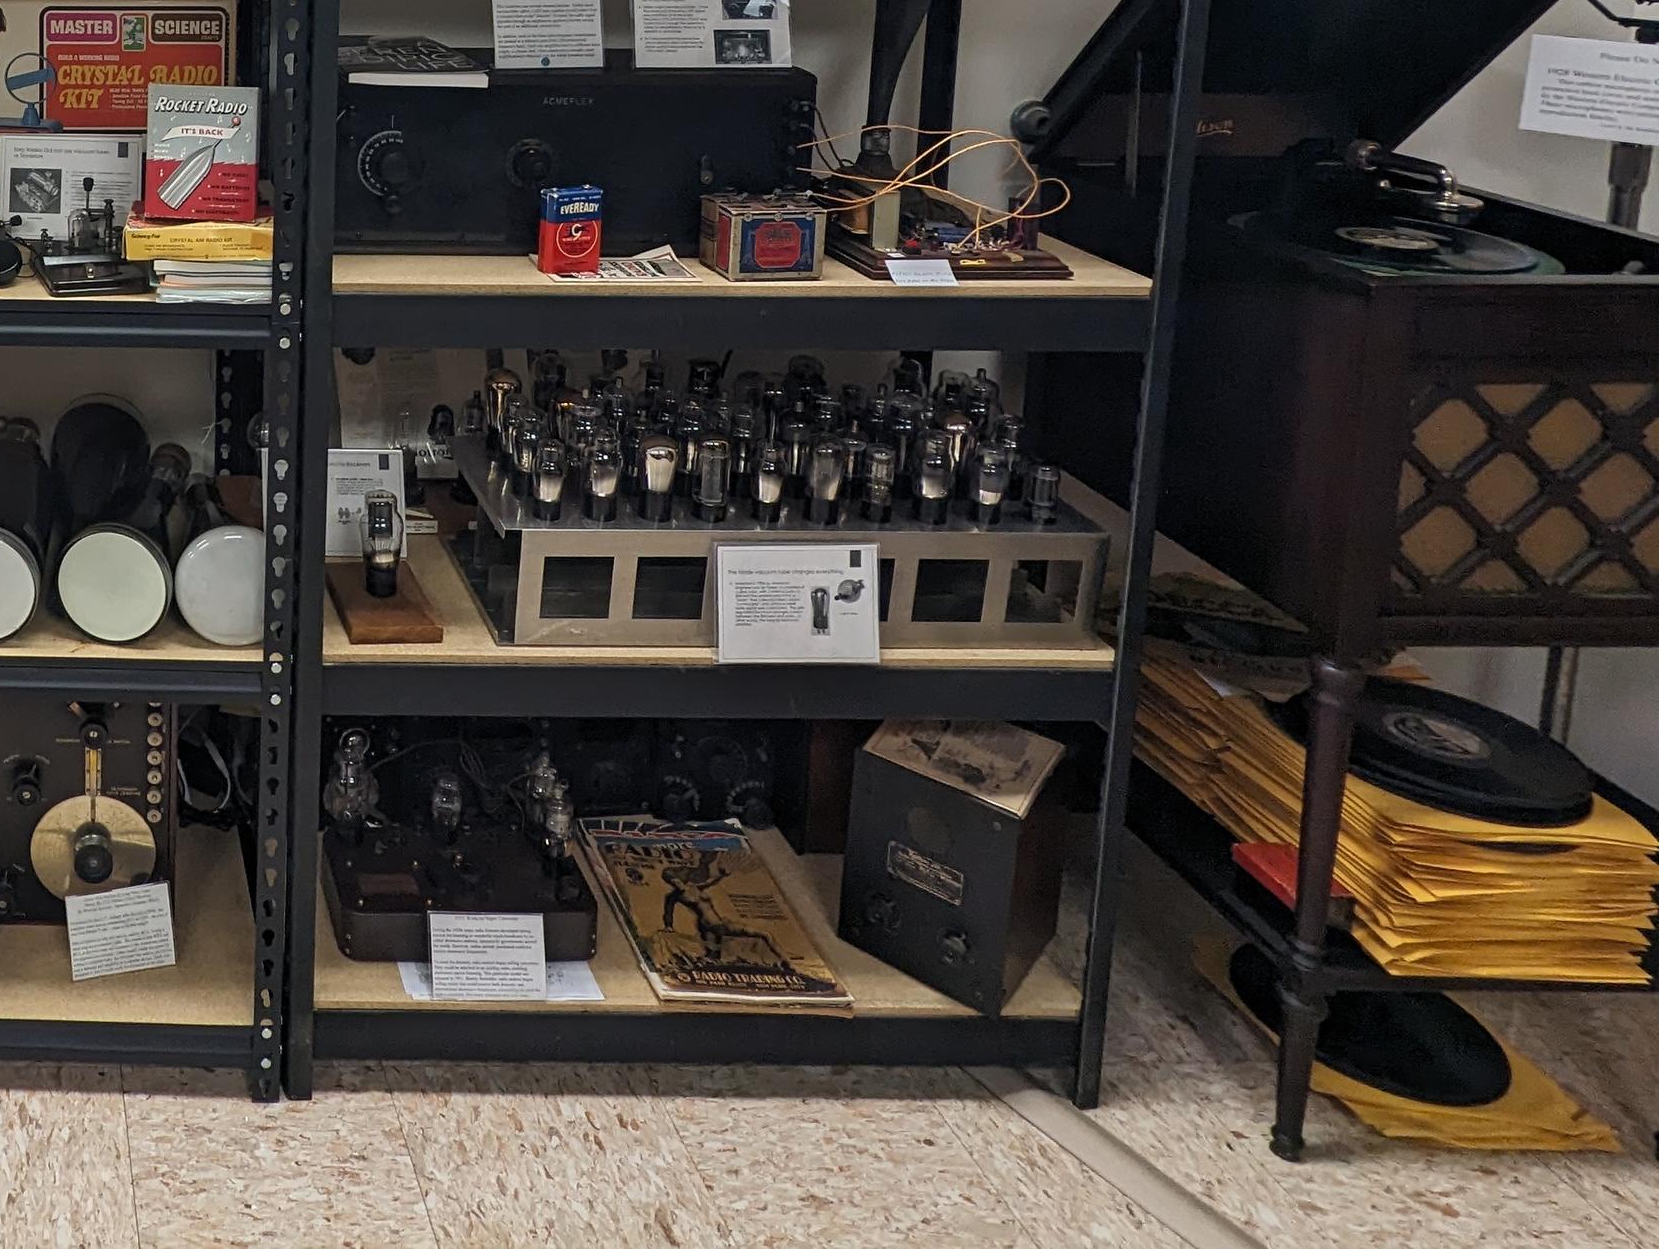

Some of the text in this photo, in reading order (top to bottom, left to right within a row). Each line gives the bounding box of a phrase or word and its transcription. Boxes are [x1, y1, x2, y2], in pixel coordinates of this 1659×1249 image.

[51, 20, 220, 35] MASTER SCIENCE
[58, 64, 218, 85] CRYSTAL RADIO
[60, 88, 103, 109] KIT
[155, 97, 204, 113] ROCKET
[206, 98, 248, 115] RADIO
[560, 202, 600, 215] EVEREADY
[692, 970, 733, 984] RADIO
[736, 972, 784, 984] TRADING
